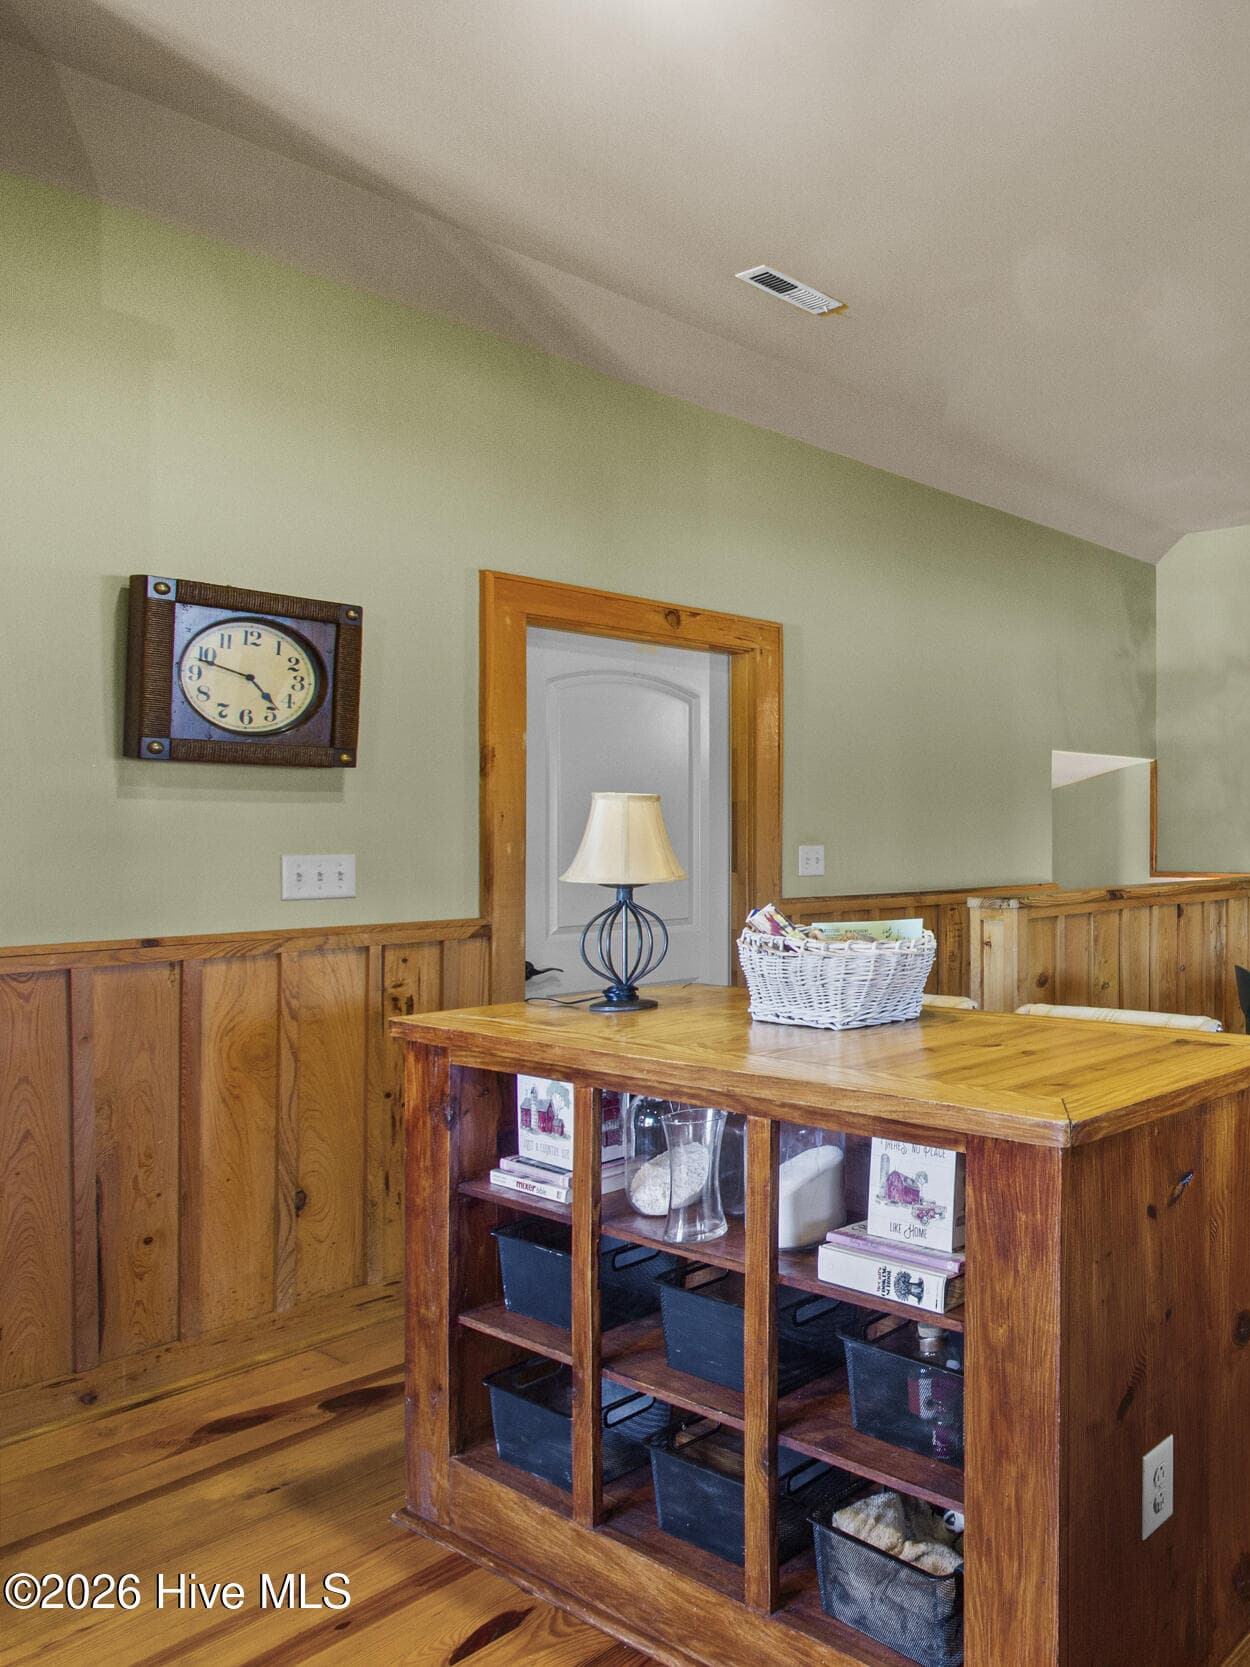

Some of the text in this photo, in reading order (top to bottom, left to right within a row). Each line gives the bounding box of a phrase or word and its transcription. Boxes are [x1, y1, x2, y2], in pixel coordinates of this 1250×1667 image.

[218, 632, 232, 650] 11
[243, 629, 262, 647] 12
[198, 646, 217, 665] 10
[274, 640, 282, 656] 1
[188, 664, 202, 682] 9
[287, 656, 300, 673] 2
[291, 675, 305, 692] 3
[196, 685, 210, 702] 8
[283, 693, 295, 709] 4
[216, 702, 230, 719] 7
[239, 709, 254, 725] 6
[263, 706, 279, 722] 5
[880, 1138, 908, 1155] THERES
[923, 1146, 945, 1160] PLACE
[516, 1180, 536, 1192] mixer
[889, 1221, 927, 1240] LIKE HOME
